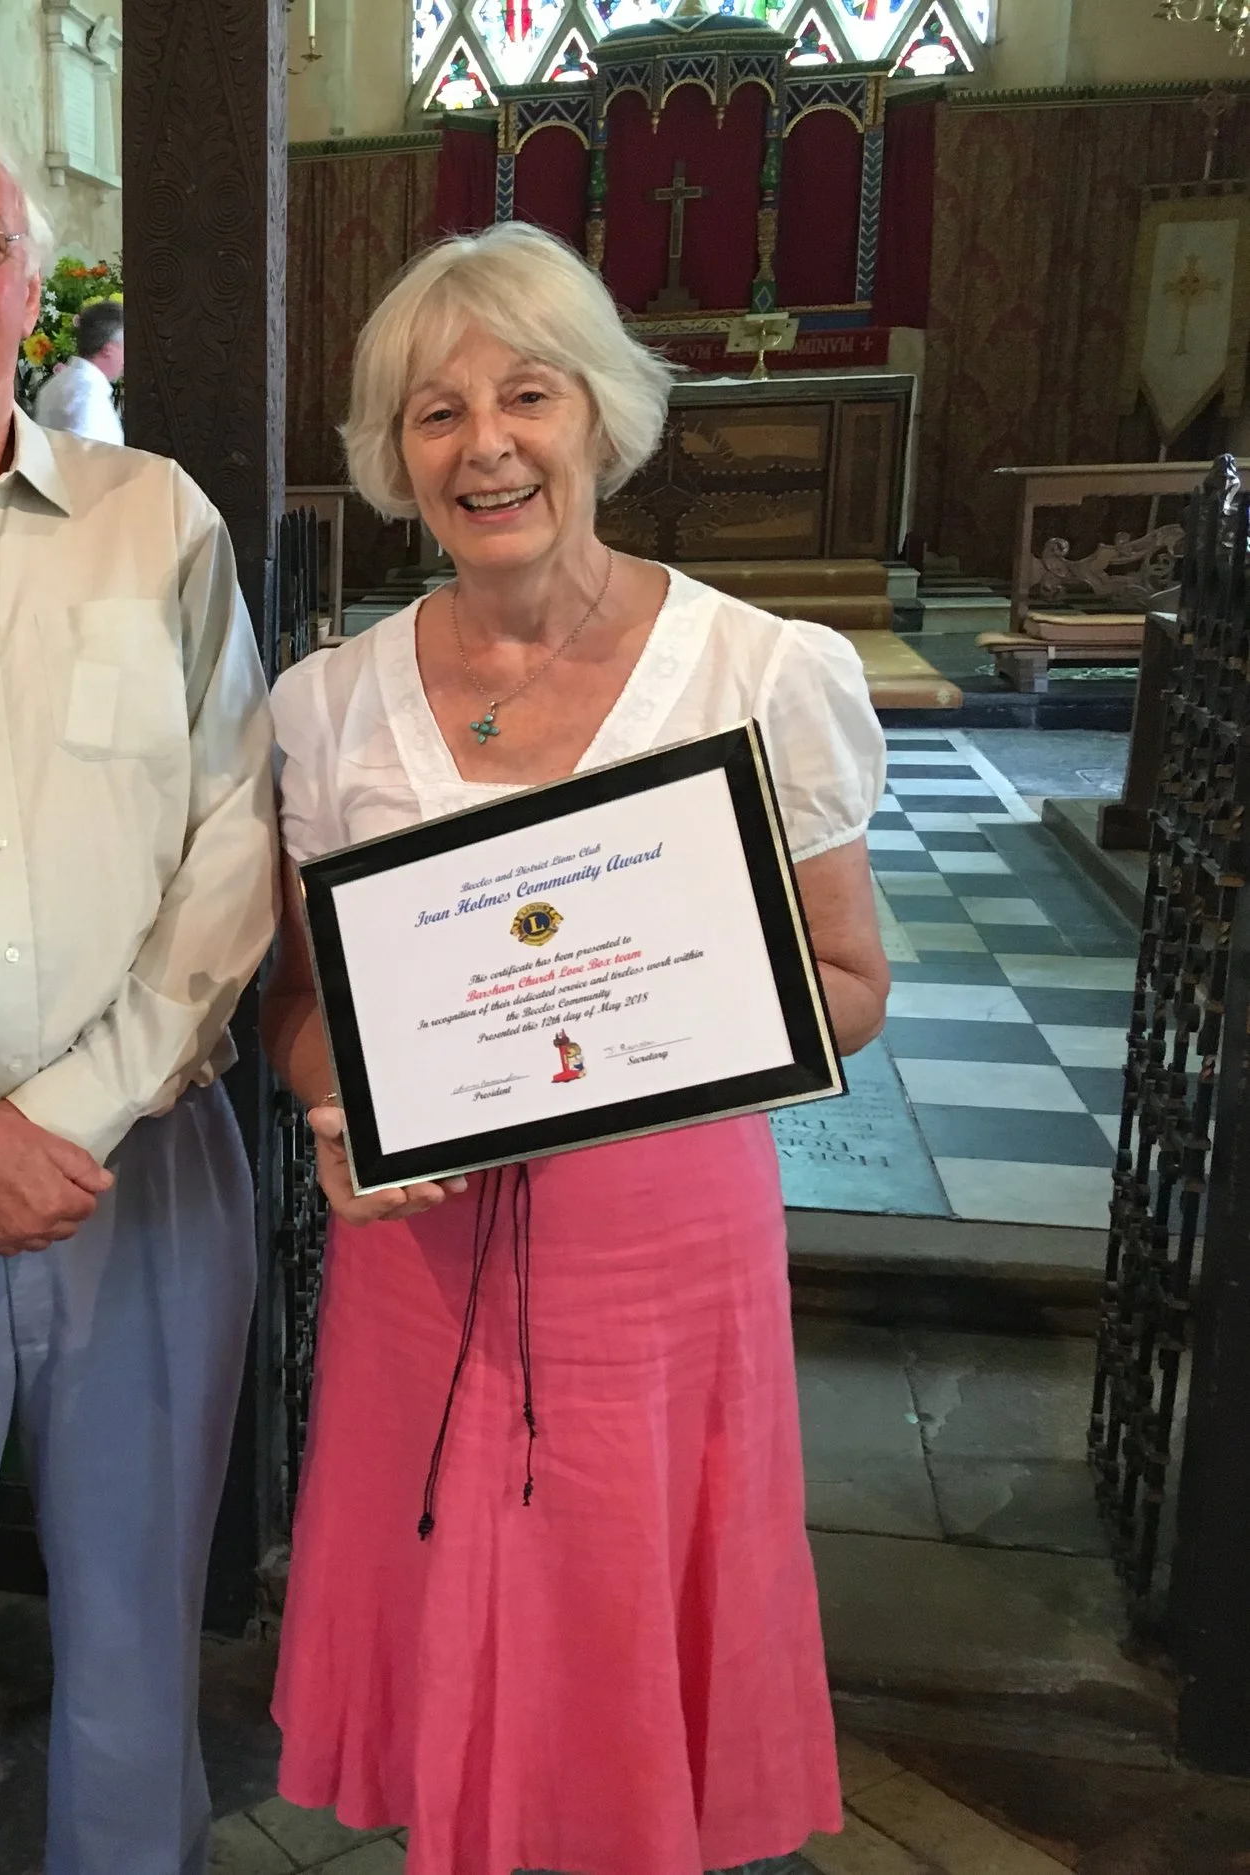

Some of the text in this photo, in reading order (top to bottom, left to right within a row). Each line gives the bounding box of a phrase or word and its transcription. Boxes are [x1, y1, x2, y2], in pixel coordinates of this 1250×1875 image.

[414, 841, 664, 928] Ivan Holmes Community Award
[459, 843, 602, 893] Beccles and District Lions Club
[528, 915, 546, 933] L
[466, 949, 642, 1003] Barsham Church Love Box team
[468, 936, 632, 986] This certificate has been presented to
[417, 949, 704, 1031] In recognition of their dedicated service and tireless work within
[506, 989, 611, 1023] the Beccles Community
[477, 992, 650, 1044] Presented this 12th day of May 2018
[626, 1049, 669, 1067] Secretary
[472, 1085, 512, 1102] President
